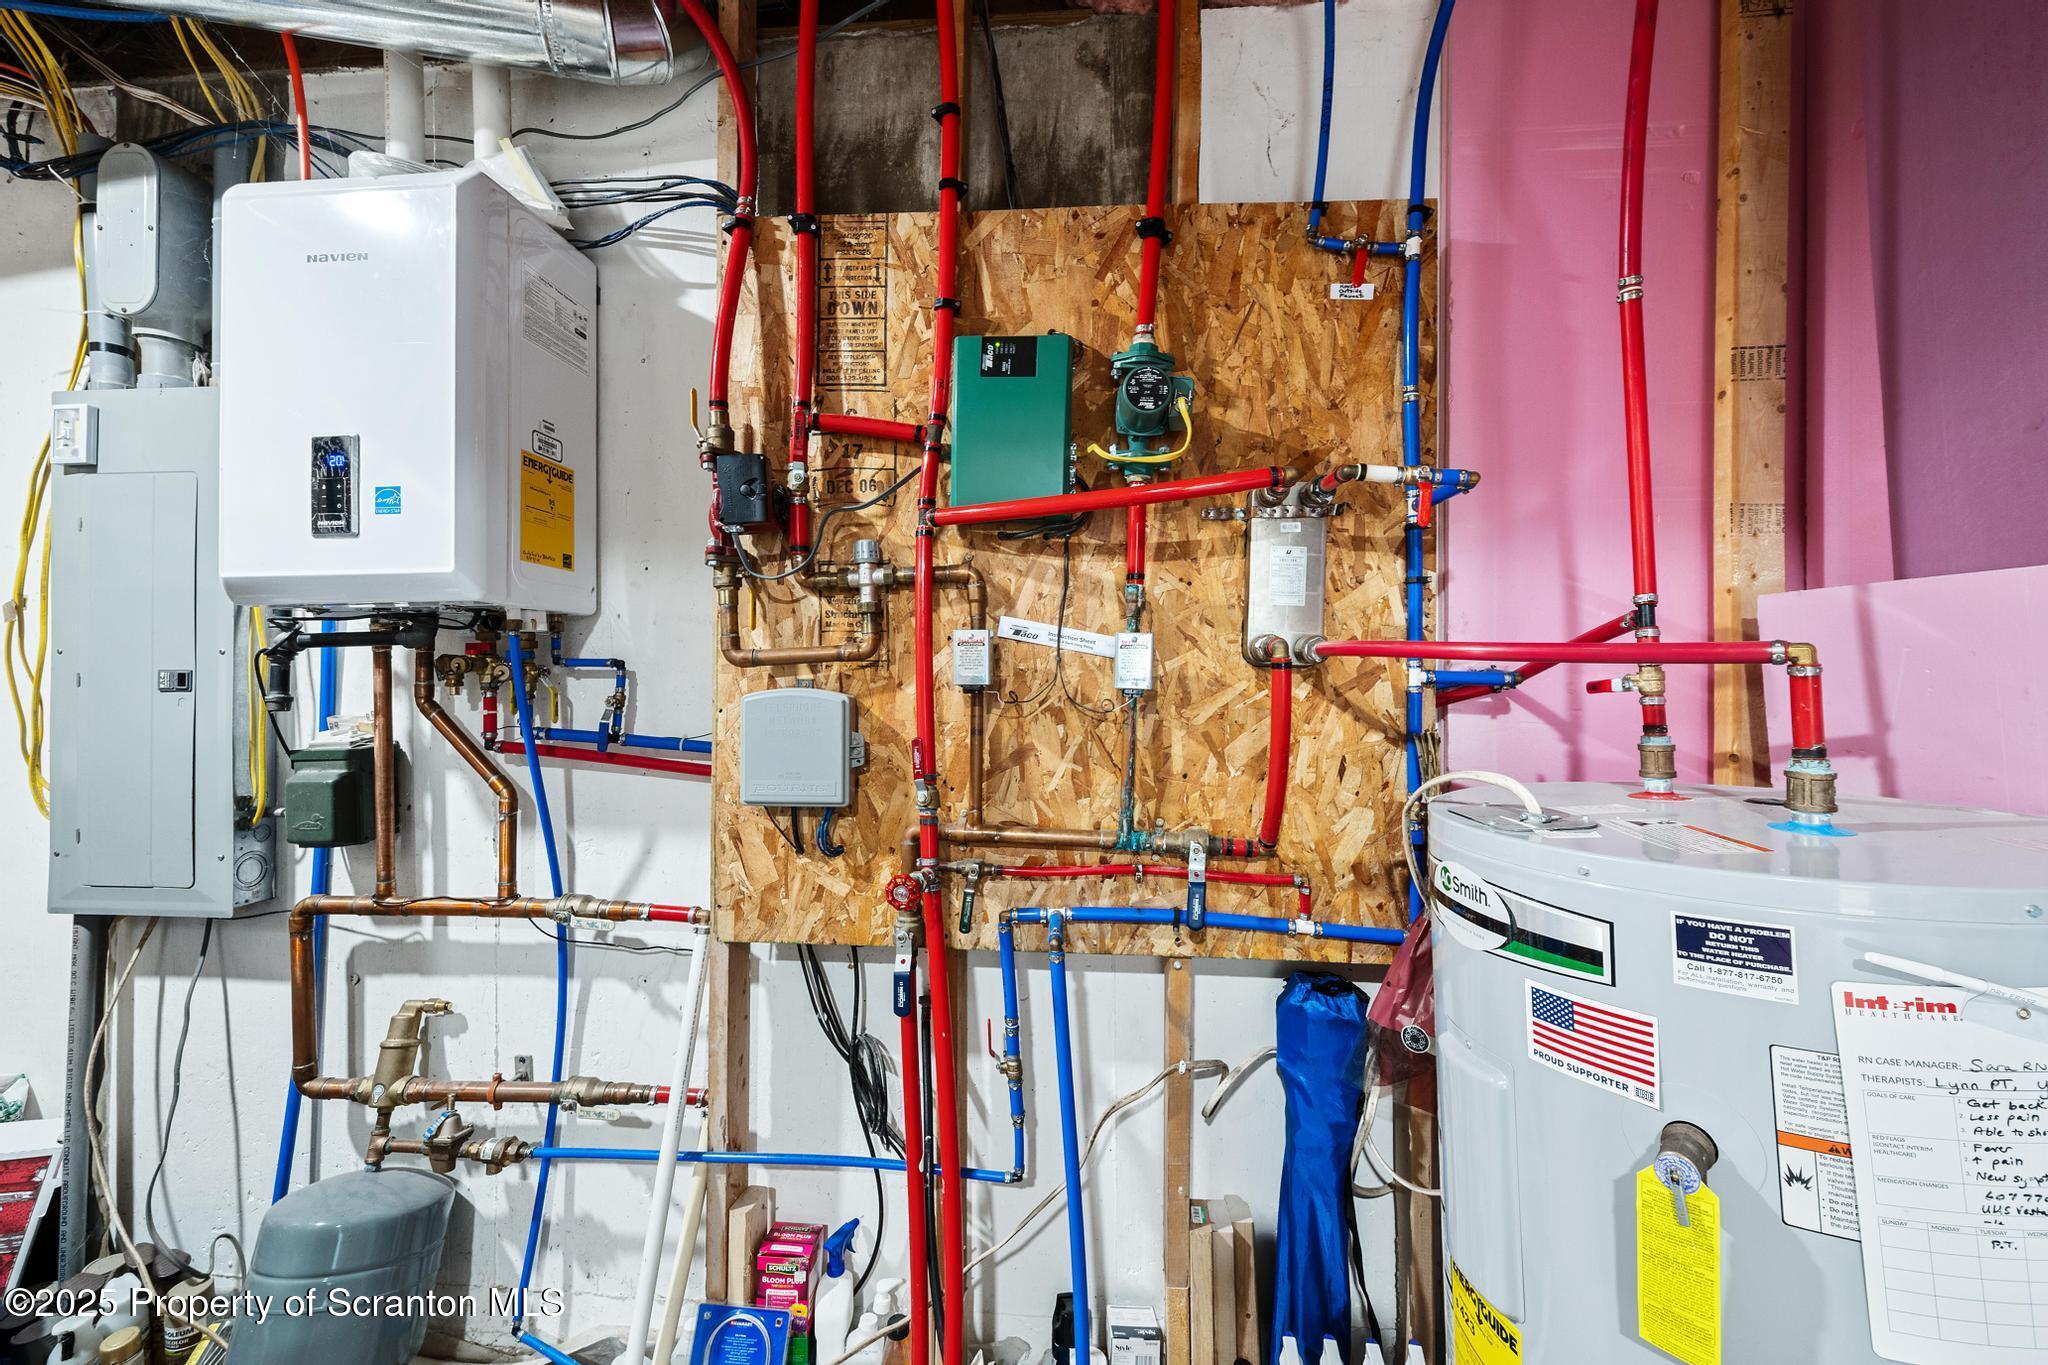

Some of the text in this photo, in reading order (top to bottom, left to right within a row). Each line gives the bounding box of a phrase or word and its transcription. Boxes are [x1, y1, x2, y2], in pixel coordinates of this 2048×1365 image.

[854, 290, 877, 299] SIDE
[827, 301, 878, 315] DOWN
[842, 443, 863, 460] 17
[826, 479, 877, 494] DEC 06
[1686, 920, 1705, 928] YOU
[1707, 922, 1732, 932] HAVE
[1743, 928, 1791, 939] PROBLEM
[1709, 932, 1755, 945] DO NOT
[1705, 940, 1760, 953] RETURN THIS
[1689, 952, 1705, 960] THE
[1706, 954, 1732, 964] PLACE
[1732, 958, 1743, 966] OF
[1701, 947, 1764, 961] WATER HEATER
[1678, 976, 1715, 986] performance
[1687, 963, 1783, 985] Call 1-877-817-6750
[1691, 971, 1704, 979] ALL
[1747, 982, 1778, 992] warranty
[1533, 1048, 1564, 1068] PROUD
[1566, 1062, 1630, 1092] SUPPORTER
[1857, 1055, 1962, 1071] RN CASE MANAGER:
[2022, 1062, 2048, 1072] RN
[1860, 1074, 1926, 1087] THERAPISTS:
[1935, 1077, 1979, 1095] Lynn
[1967, 1099, 2048, 1111] Get back
[2007, 1113, 2040, 1127] pain
[1973, 1126, 2024, 1137] Able to
[1992, 1156, 2024, 1170] pain
[1876, 1177, 1950, 1190] MEDICATION CHANGES
[1976, 1171, 2007, 1182] New
[1829, 1206, 1854, 1217] Do not
[1881, 1218, 1908, 1227] SUNDAY
[1930, 1224, 1961, 1232] MONDAY
[1979, 1229, 2008, 1237] TUESDAY
[768, 1264, 797, 1272] SCHULTZ
[761, 1276, 786, 1284] BLOOM
